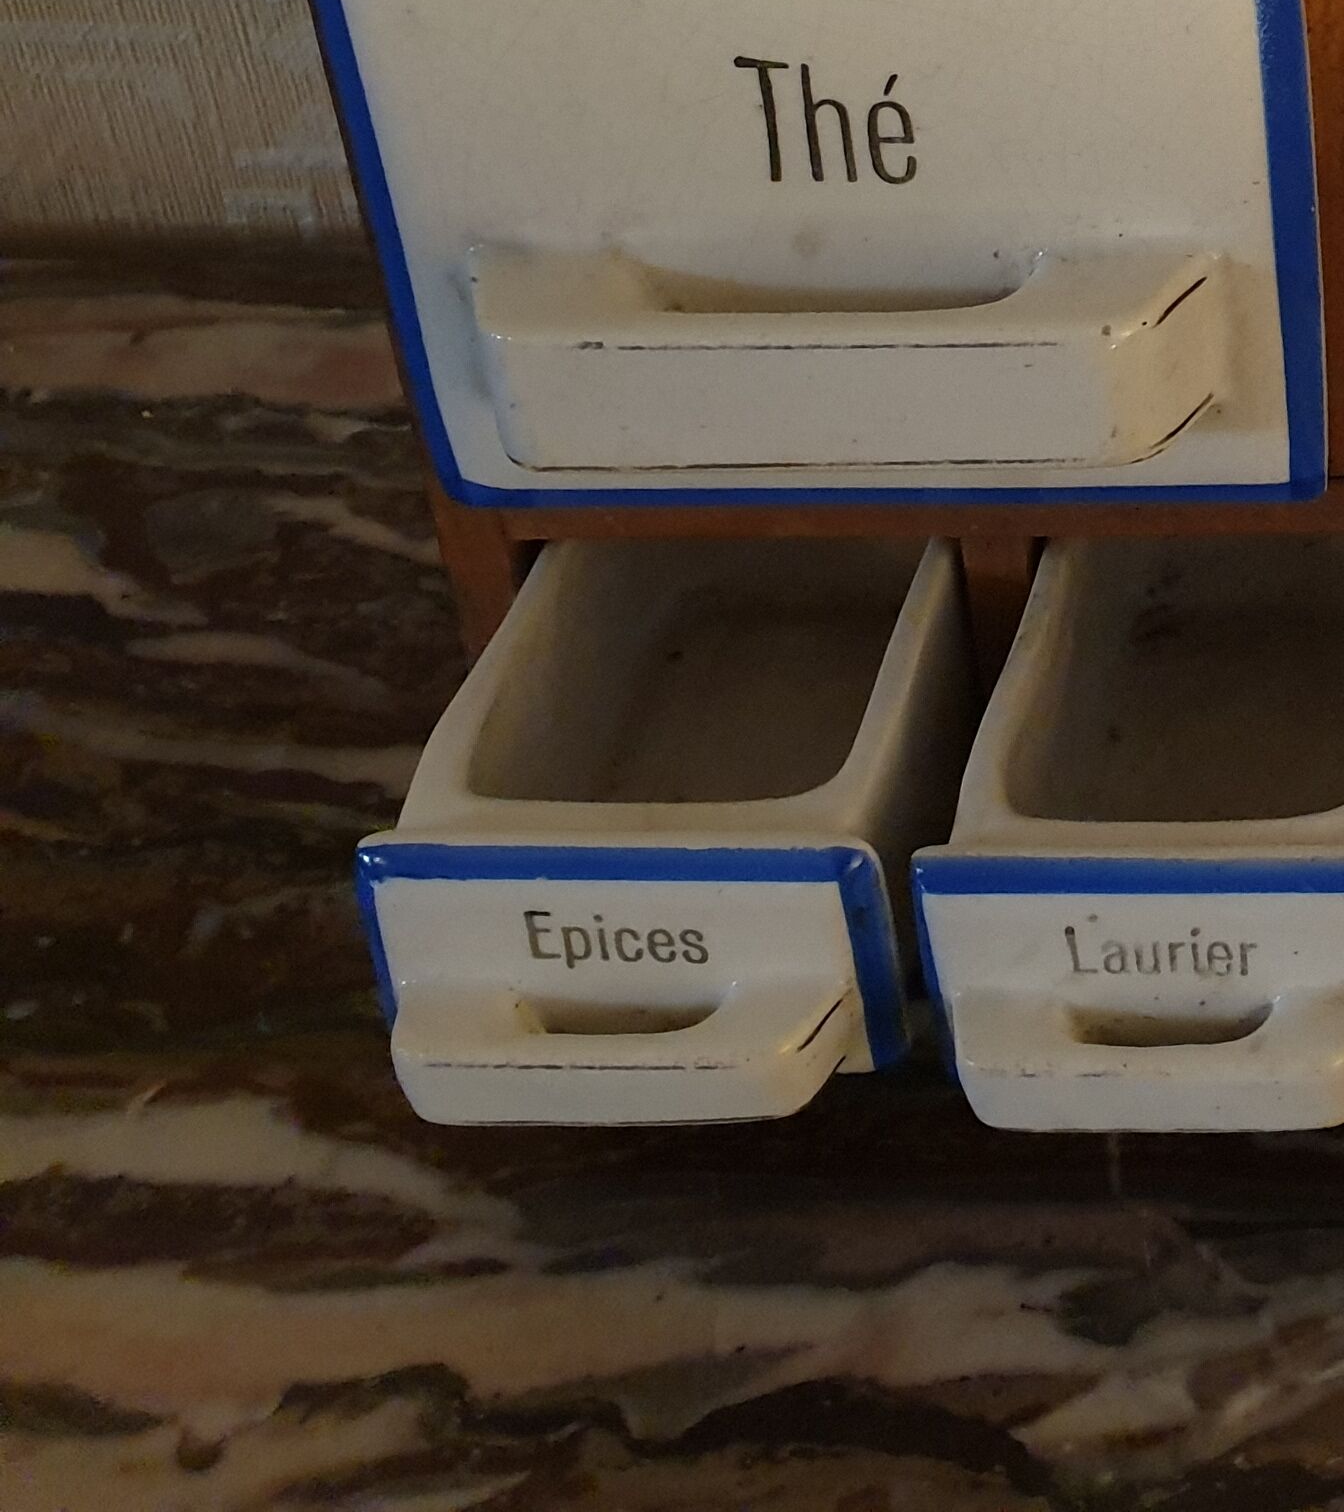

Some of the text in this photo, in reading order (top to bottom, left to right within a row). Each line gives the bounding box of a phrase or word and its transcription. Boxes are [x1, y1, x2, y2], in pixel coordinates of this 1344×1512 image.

[733, 55, 917, 185] Thé
[523, 909, 709, 970] Epices
[1064, 925, 1258, 977] Laurier
